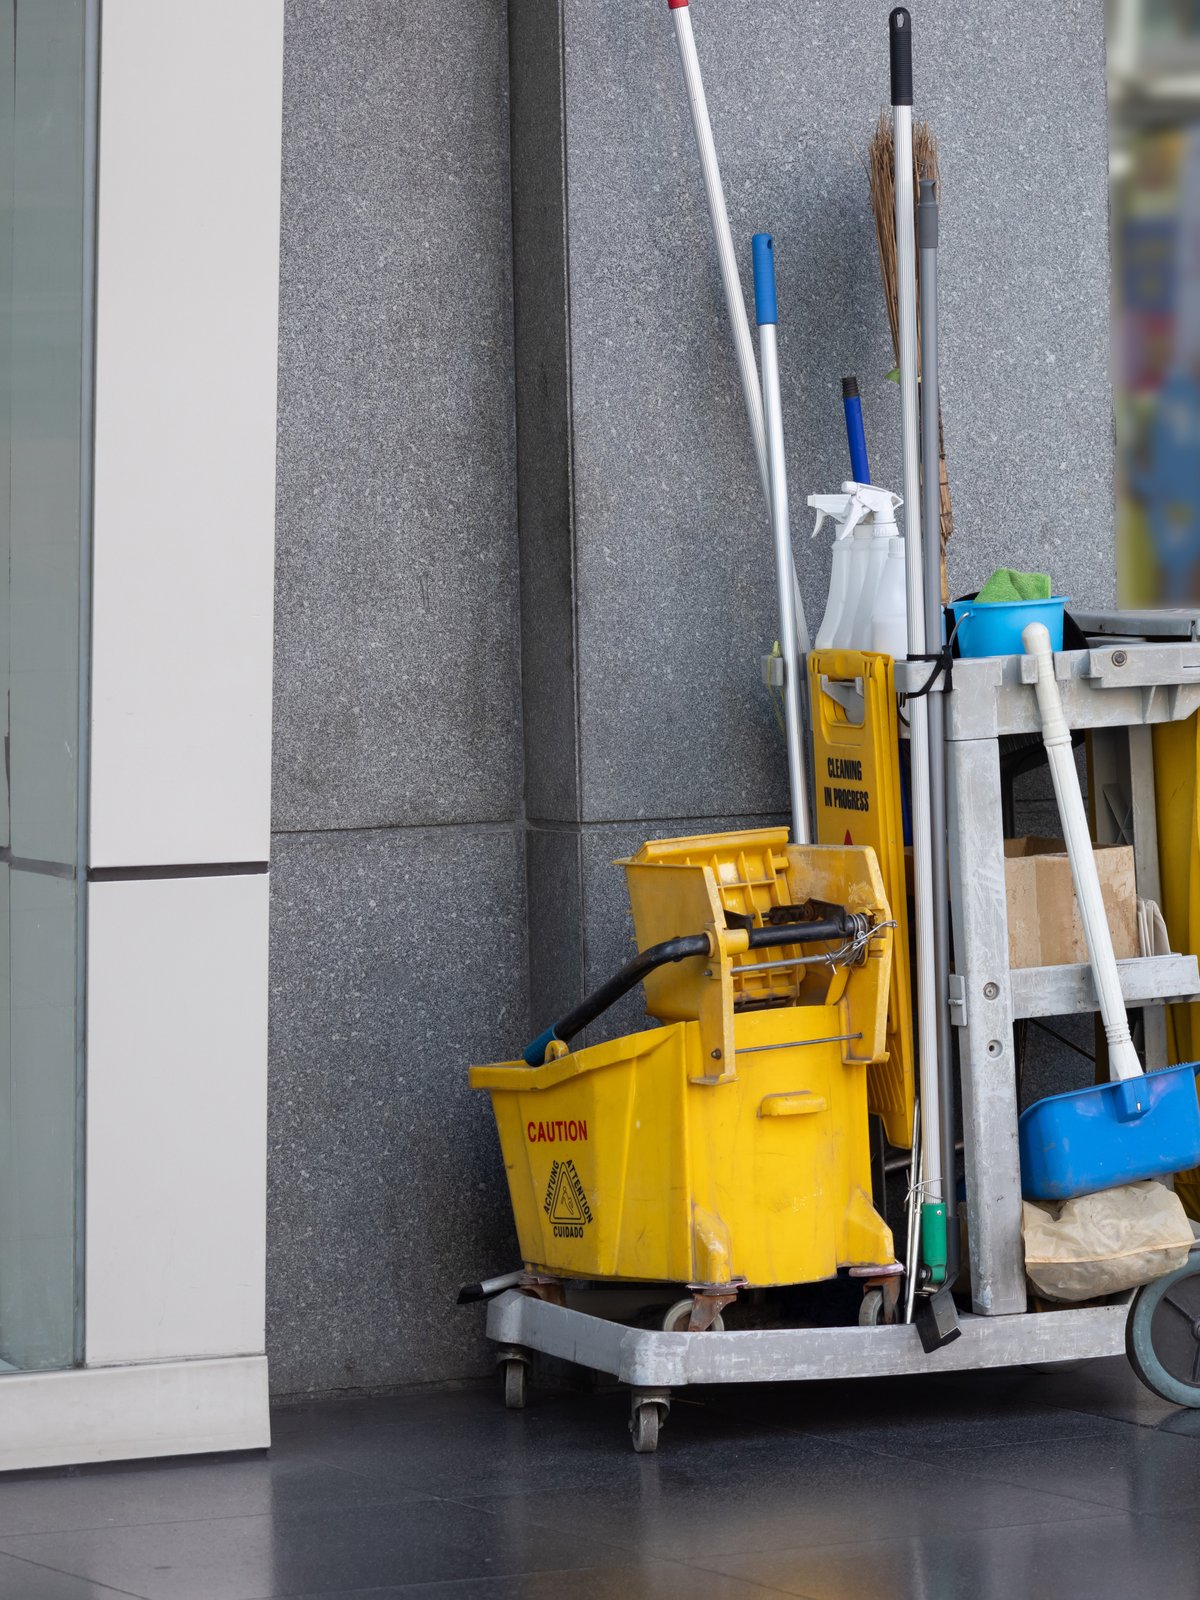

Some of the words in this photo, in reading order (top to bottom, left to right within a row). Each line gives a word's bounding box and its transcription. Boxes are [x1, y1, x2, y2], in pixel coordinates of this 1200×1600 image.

[827, 757, 861, 780] CLEANING
[824, 787, 832, 806] IN
[834, 788, 869, 812] PROGRESS
[527, 1120, 587, 1142] CAUTION
[543, 1159, 560, 1214] ACHTUNG
[566, 1159, 593, 1224] ATTENTION
[553, 1226, 583, 1238] CUIDADO
